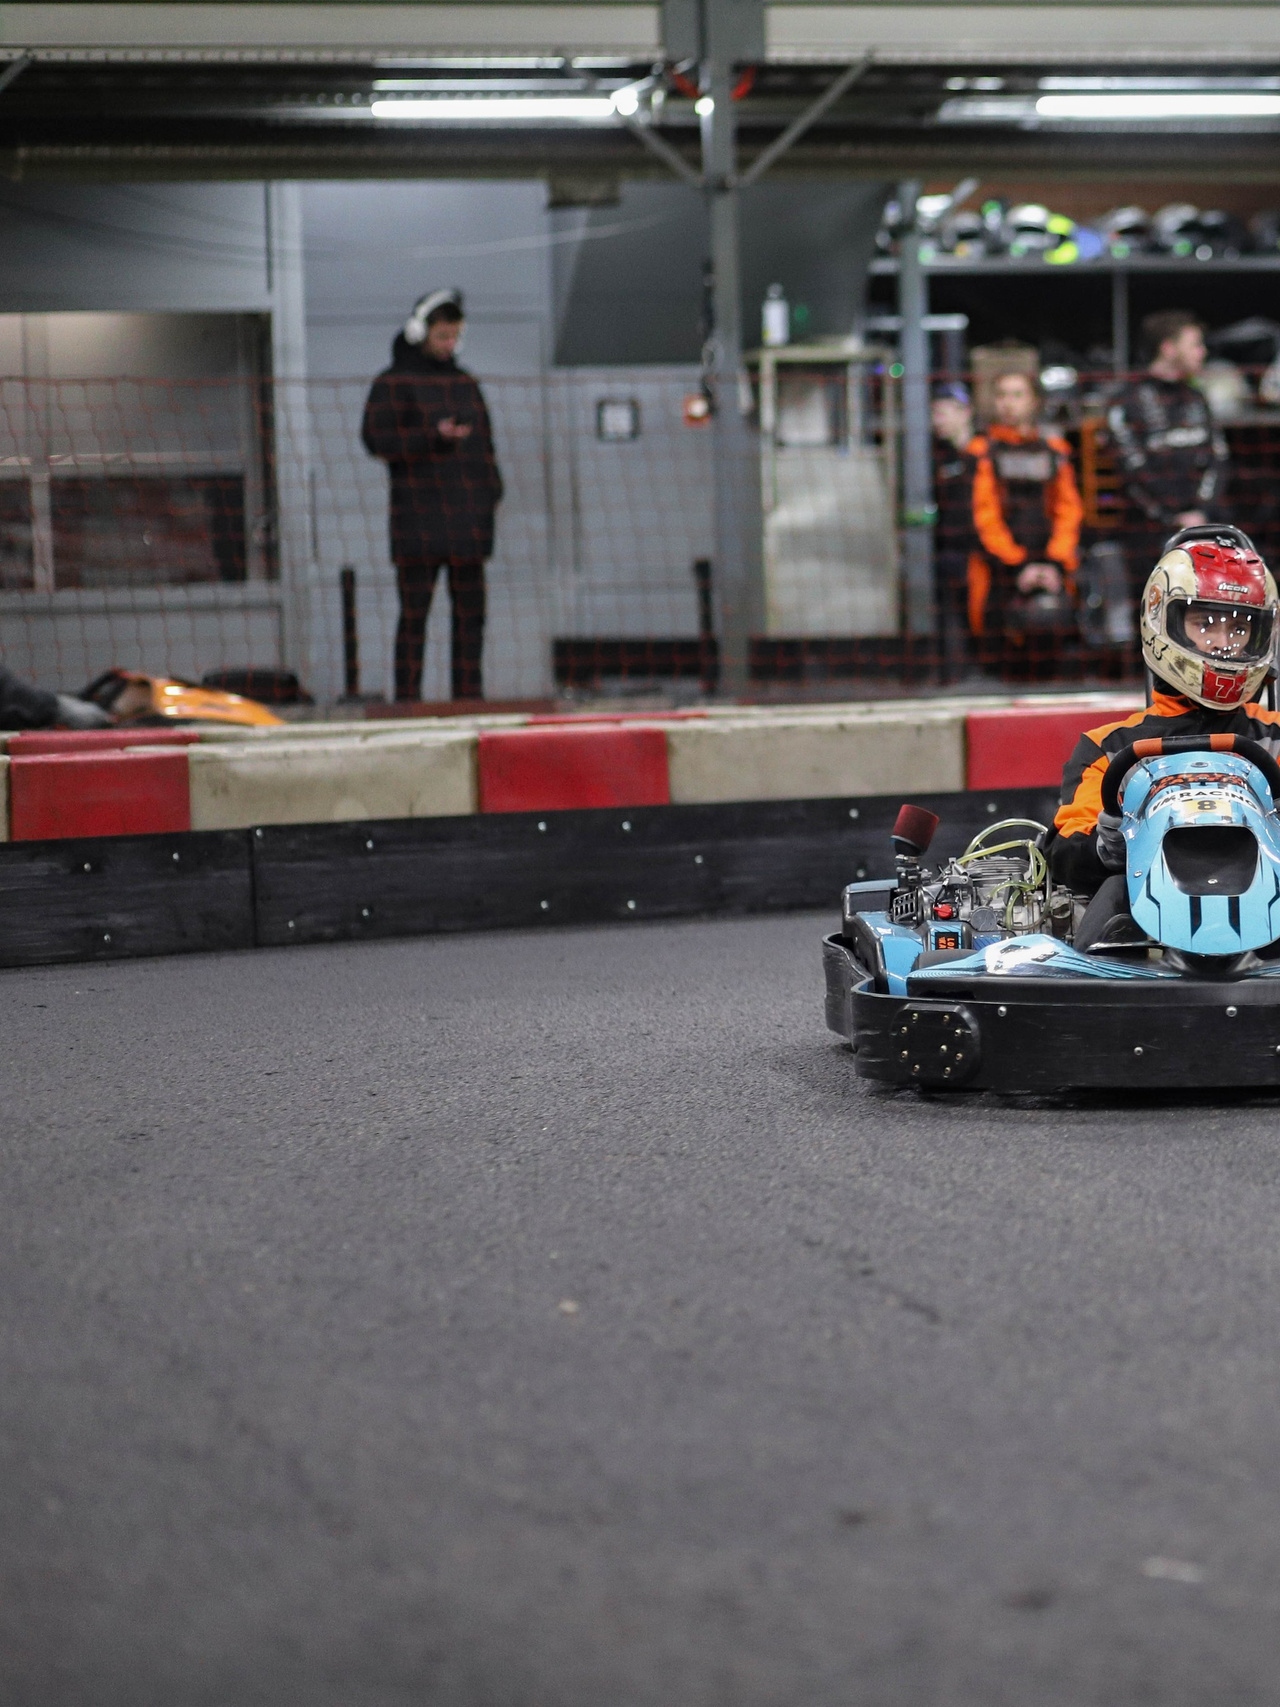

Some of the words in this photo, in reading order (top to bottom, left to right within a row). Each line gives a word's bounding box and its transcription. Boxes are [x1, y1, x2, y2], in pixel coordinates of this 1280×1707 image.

[1216, 676, 1236, 698] 7
[1179, 791, 1257, 809] RACING
[1197, 800, 1217, 811] 8
